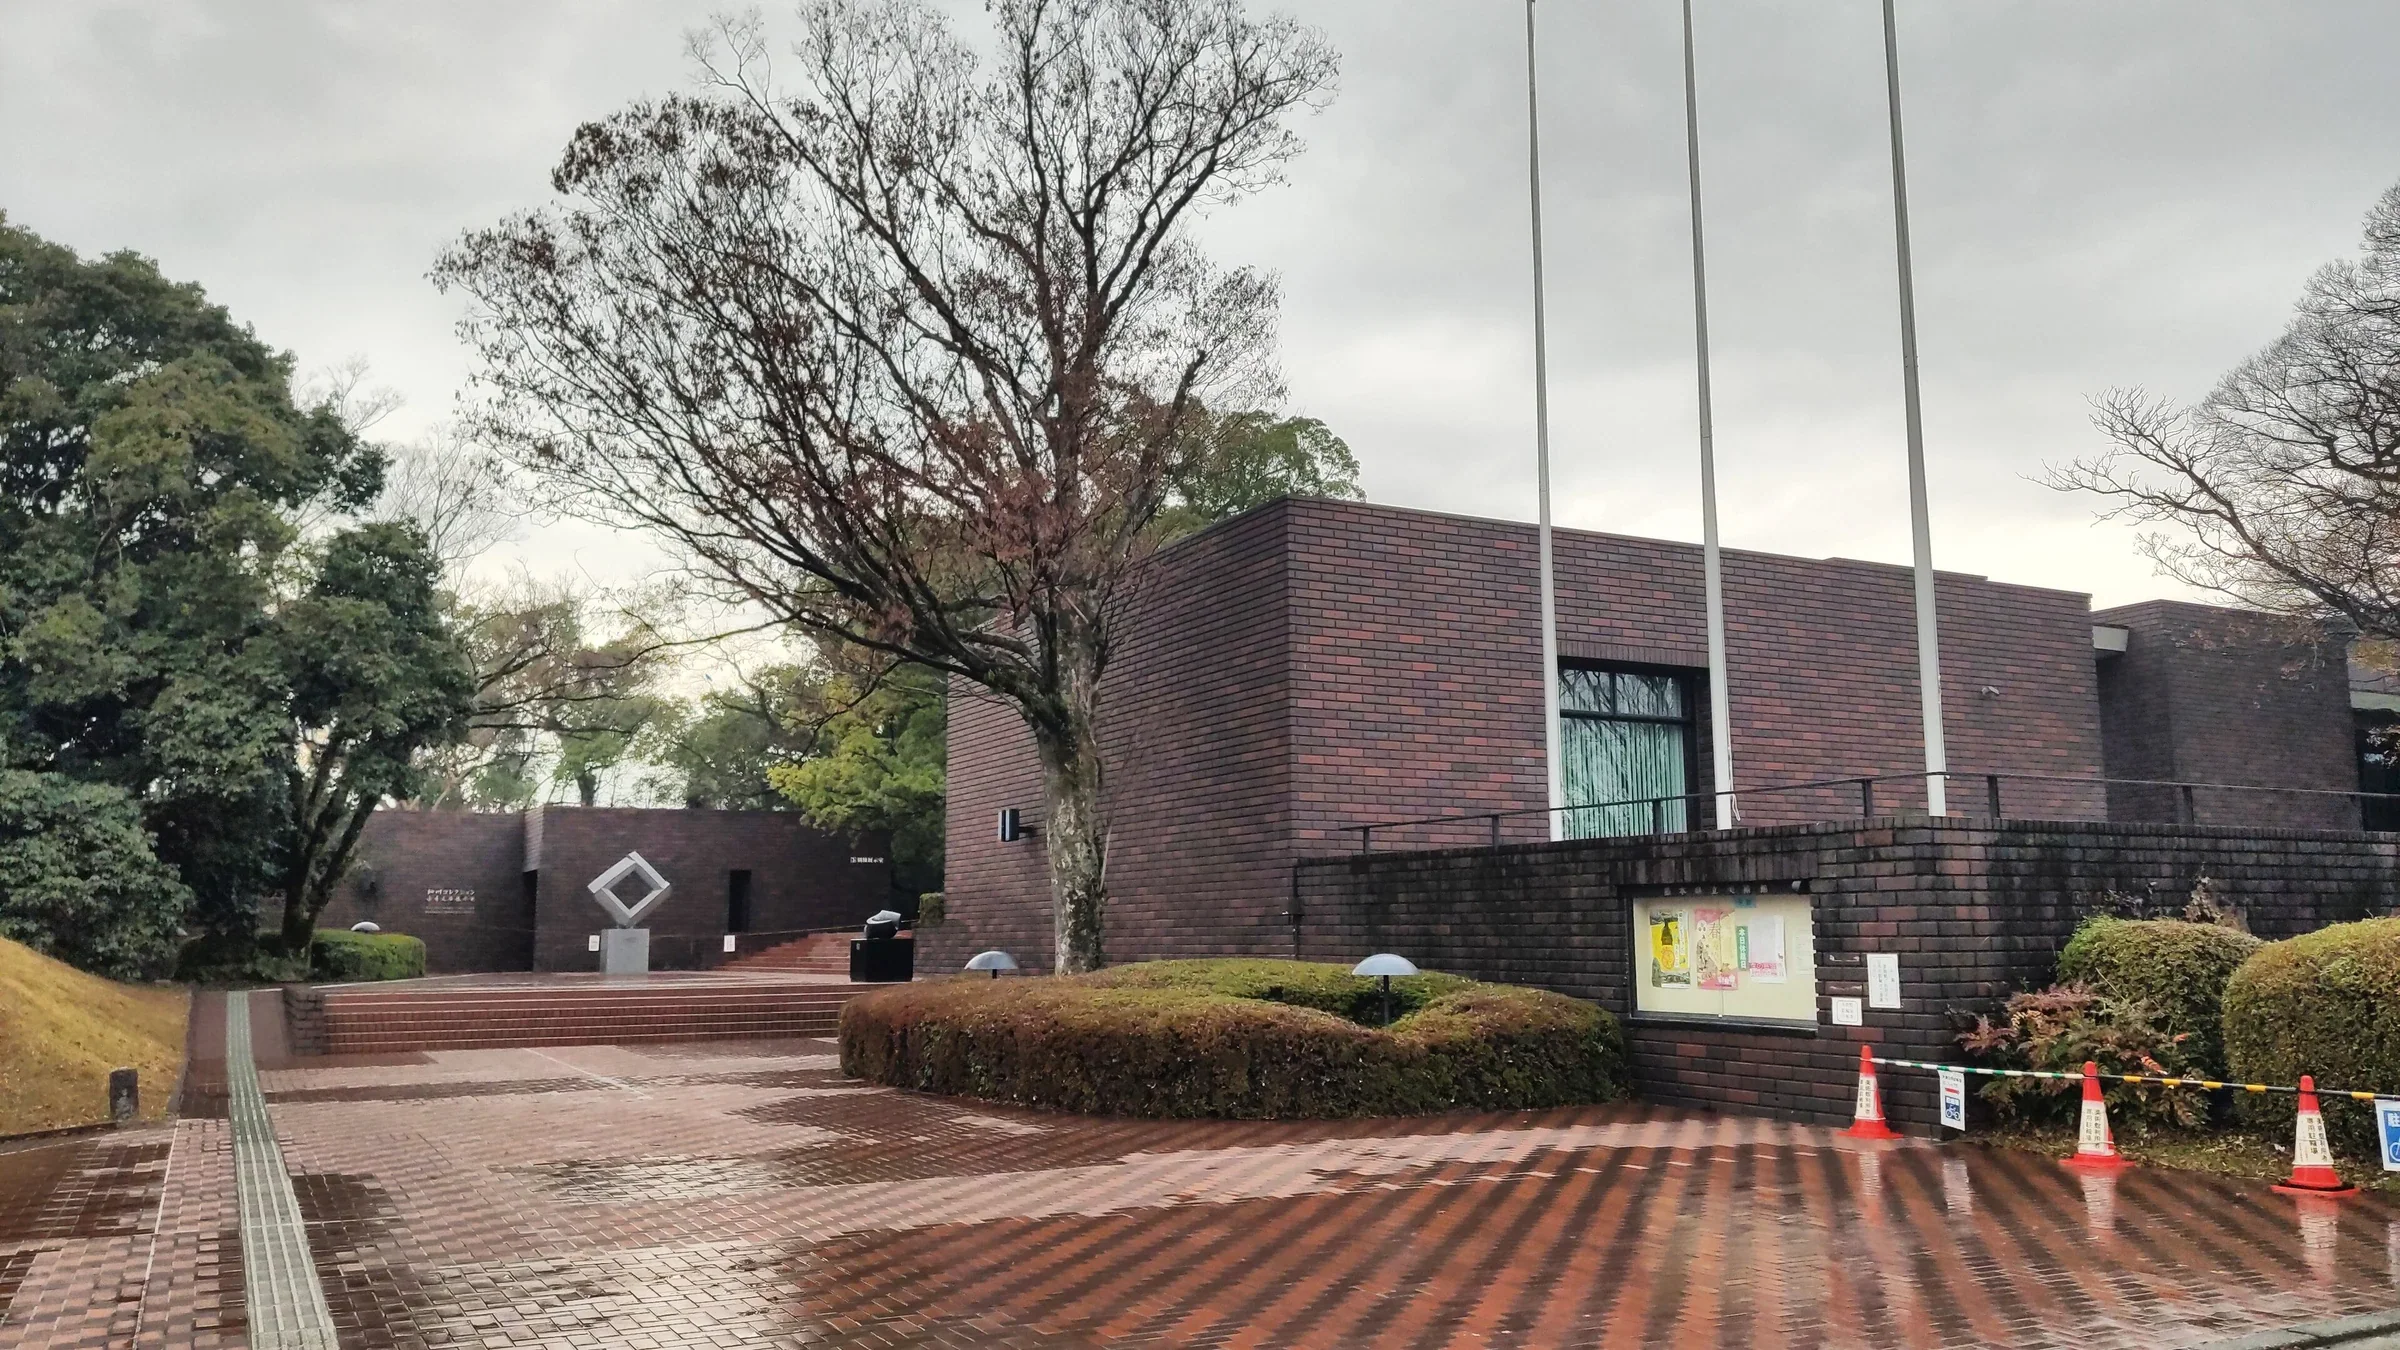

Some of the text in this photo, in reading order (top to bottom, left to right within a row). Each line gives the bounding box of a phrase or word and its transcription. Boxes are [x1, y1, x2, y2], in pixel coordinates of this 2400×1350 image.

[1738, 927, 1747, 969] 本日休館日
